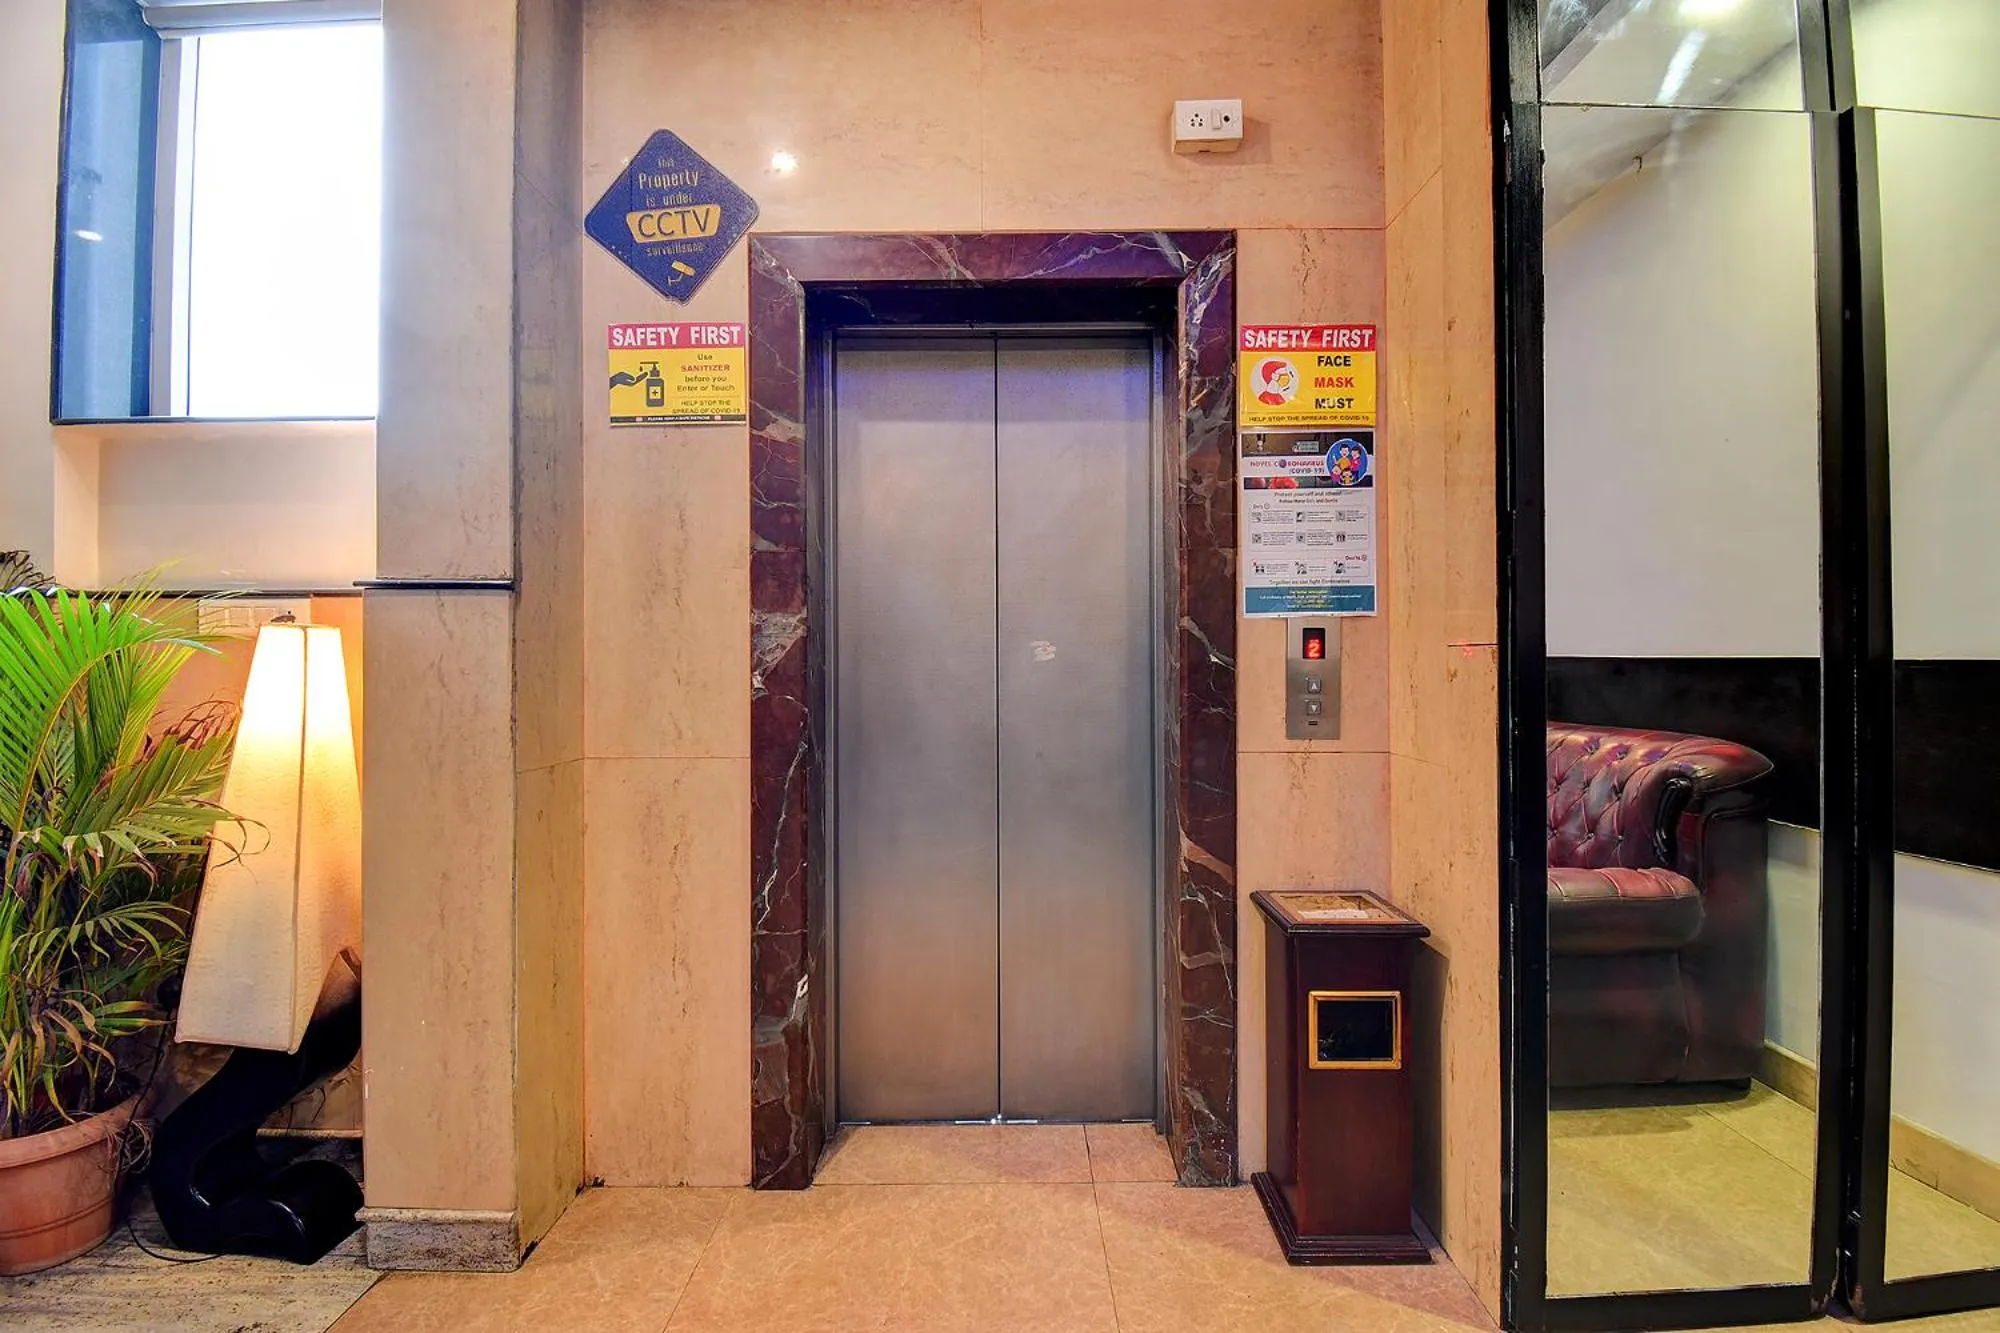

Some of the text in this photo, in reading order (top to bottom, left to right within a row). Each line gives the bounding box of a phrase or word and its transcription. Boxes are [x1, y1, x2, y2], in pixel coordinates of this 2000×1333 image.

[638, 169, 700, 190] Property
[645, 192, 693, 207] is under
[638, 207, 710, 238] CCTV
[612, 326, 741, 346] SAFETY FIRST
[1244, 328, 1373, 348] SAFETY FIRST
[697, 353, 713, 361] Use
[1317, 355, 1351, 367] FACE
[680, 364, 730, 372] SANITIZER
[684, 375, 710, 383] before
[1314, 377, 1355, 388] MASK
[711, 384, 736, 392] Touch
[1314, 398, 1355, 409] MUST
[1308, 641, 1321, 658] 2
